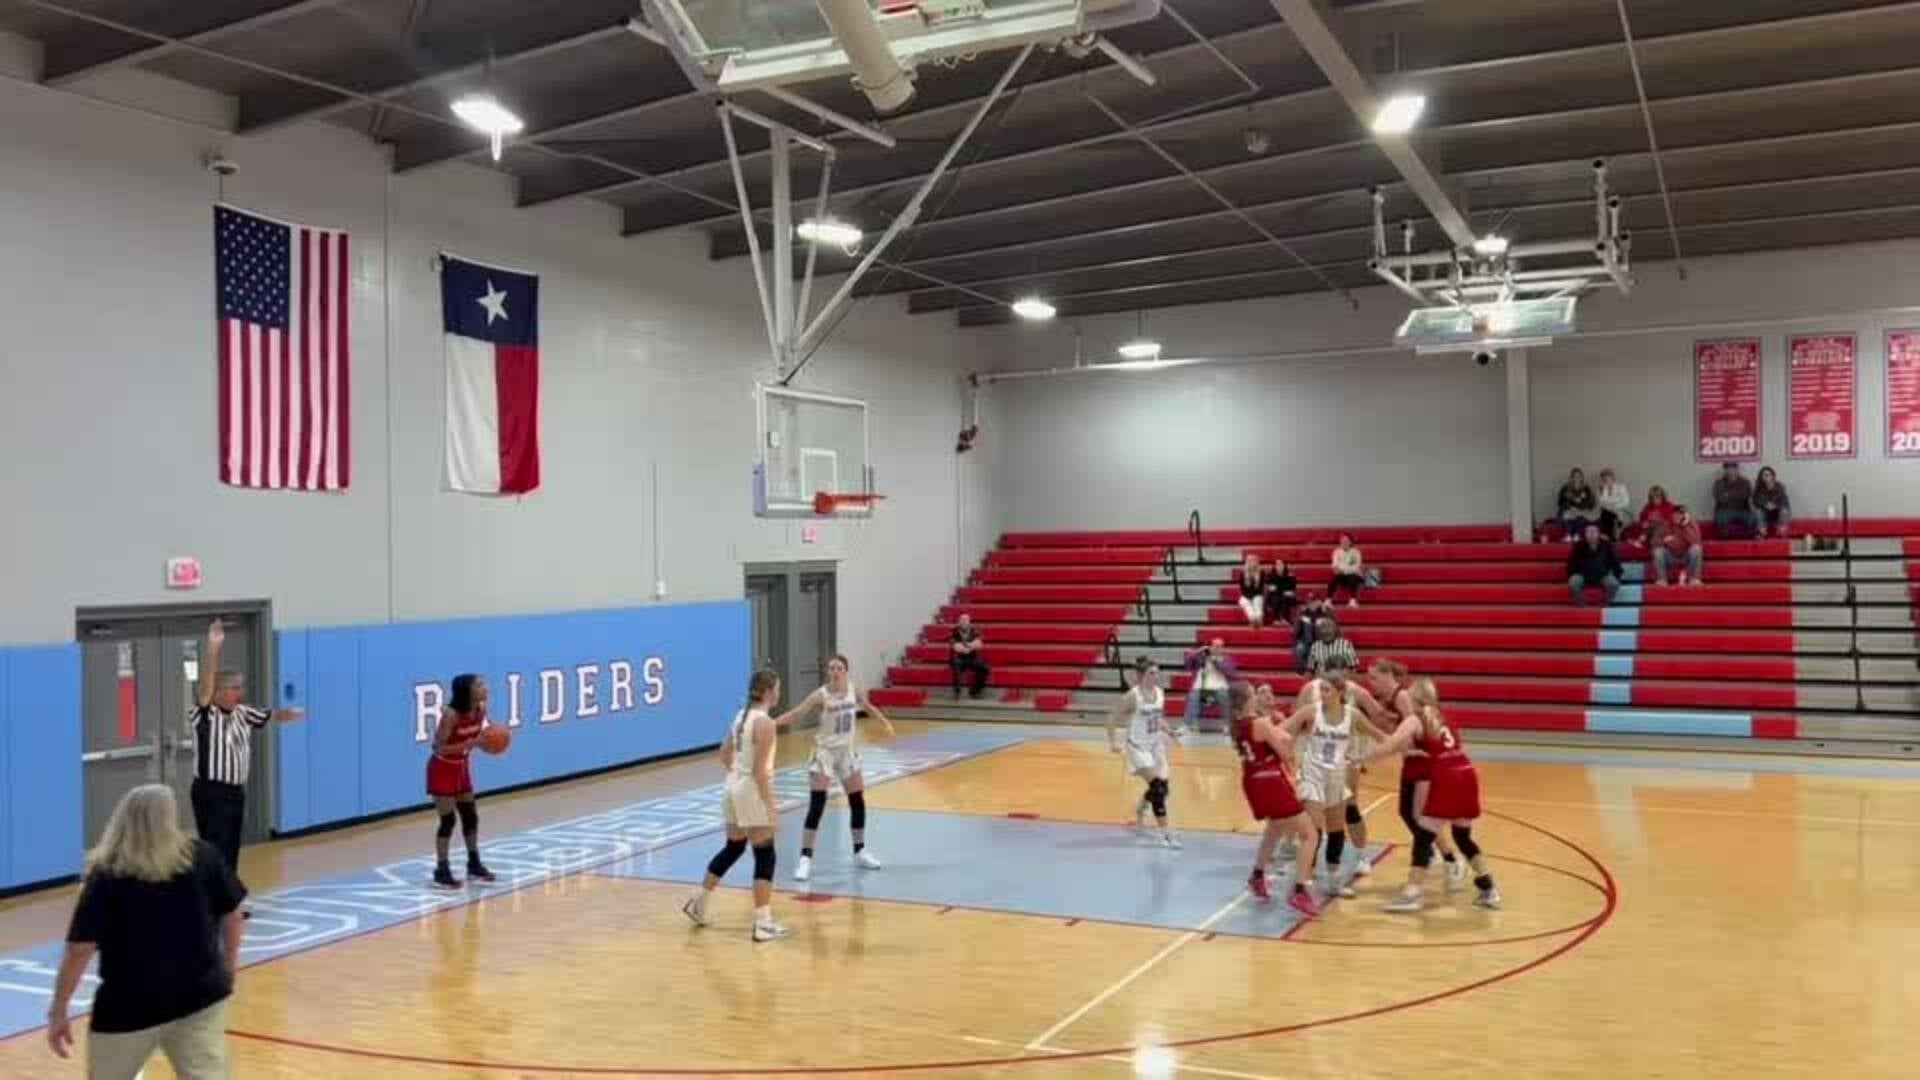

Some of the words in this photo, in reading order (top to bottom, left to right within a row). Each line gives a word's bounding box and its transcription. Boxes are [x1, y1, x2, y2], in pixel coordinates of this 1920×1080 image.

[1701, 436, 1755, 456] 2000
[1793, 432, 1850, 453] 2019
[414, 656, 665, 743] RIDERS
